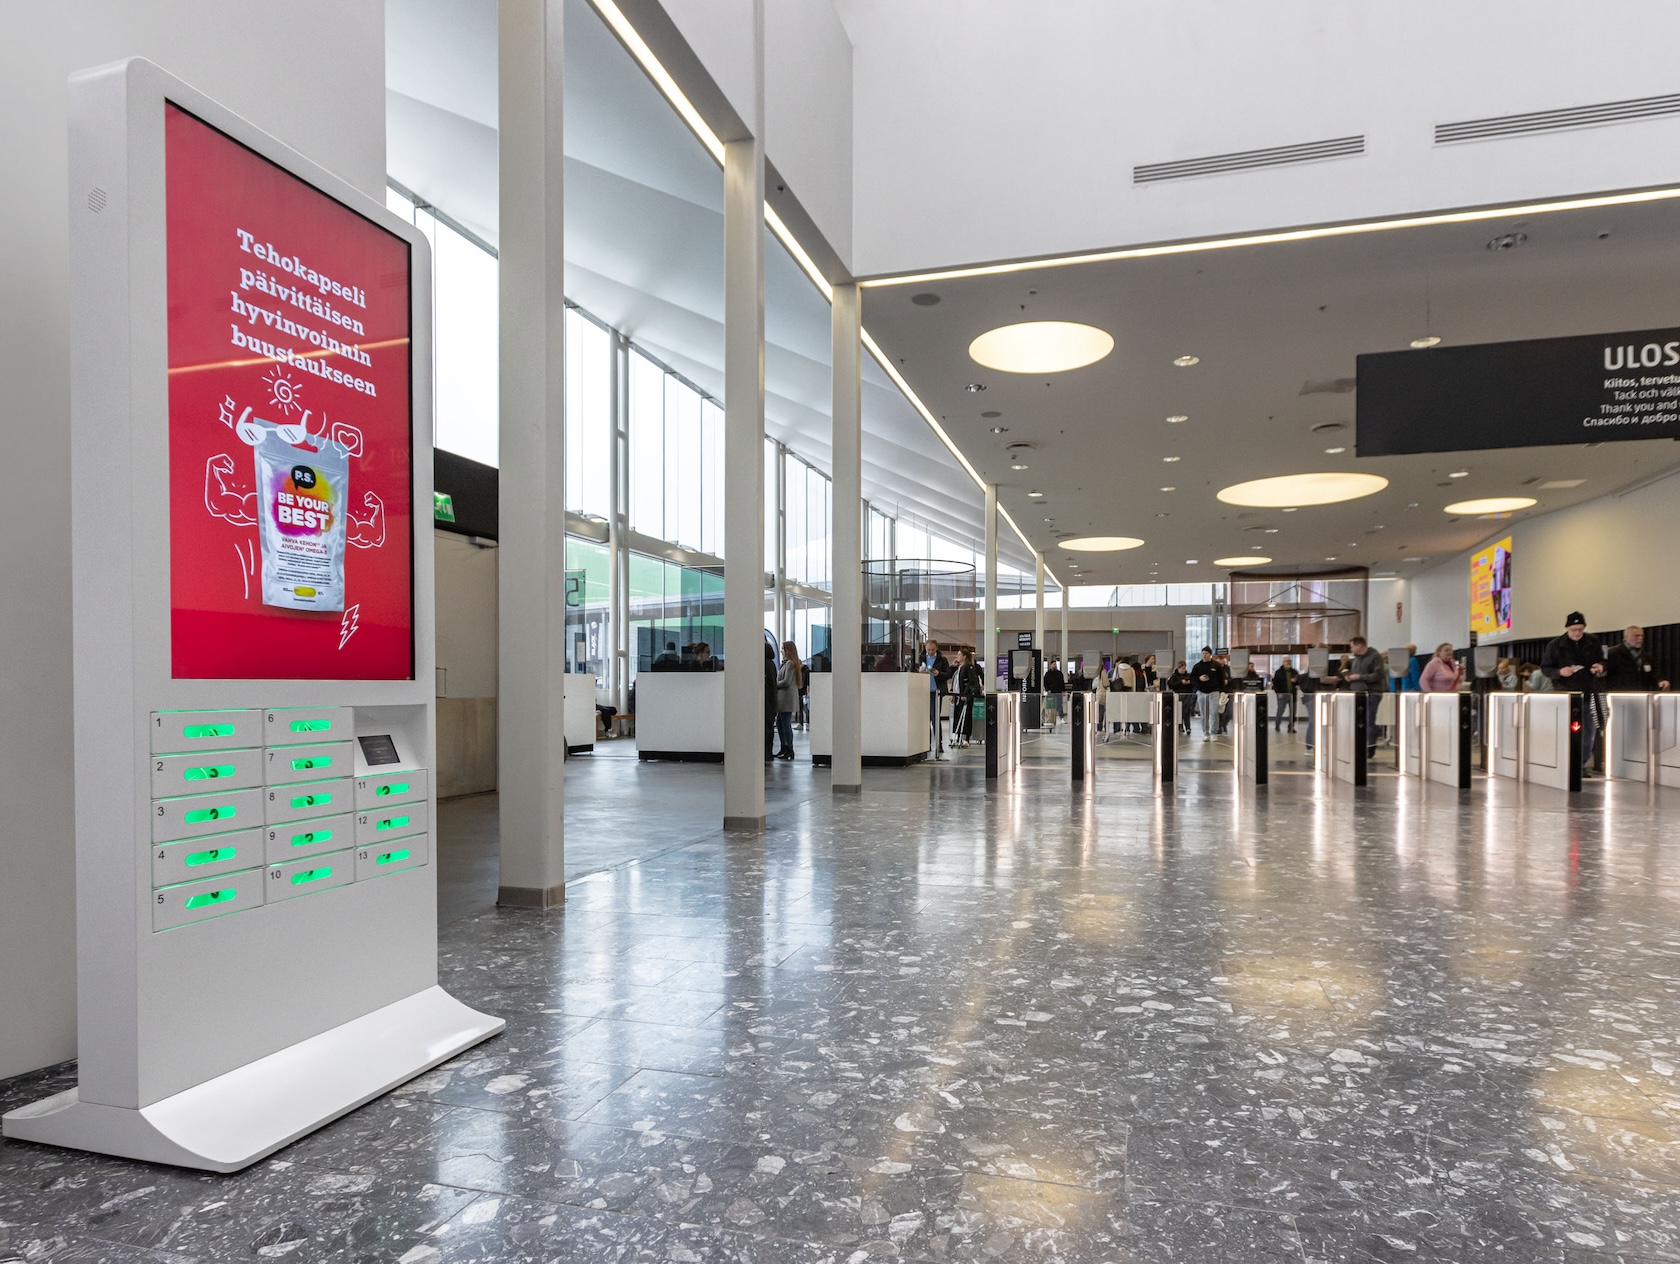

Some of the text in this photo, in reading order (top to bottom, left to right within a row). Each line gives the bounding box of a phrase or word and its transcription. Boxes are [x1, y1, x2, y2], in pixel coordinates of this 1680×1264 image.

[237, 228, 366, 309] Tehokapseli
[239, 267, 365, 336] päivittäisen
[231, 291, 372, 367] hyvinvoinnin
[231, 324, 377, 397] buustaukseen
[1604, 341, 1680, 370] ULOS
[1604, 377, 1639, 389] Kiitos,
[1613, 389, 1637, 401] Tack
[1638, 387, 1659, 399] och
[1600, 399, 1678, 414] Thank you and
[1583, 412, 1678, 427] Спасибо и добро
[294, 470, 314, 484] P.S.
[278, 491, 329, 513] BE YOUR
[278, 505, 330, 530] BEST
[156, 718, 161, 727] 1
[268, 714, 274, 722] 6
[269, 753, 274, 761] 7
[157, 762, 163, 771] 2
[358, 782, 366, 790] 11
[269, 792, 275, 801] 8
[158, 807, 164, 816] 3
[358, 816, 367, 824] 12
[269, 832, 275, 840] 9
[158, 850, 165, 859] 4
[358, 851, 367, 860] 13
[270, 870, 281, 879] 10
[158, 894, 164, 904] 5
